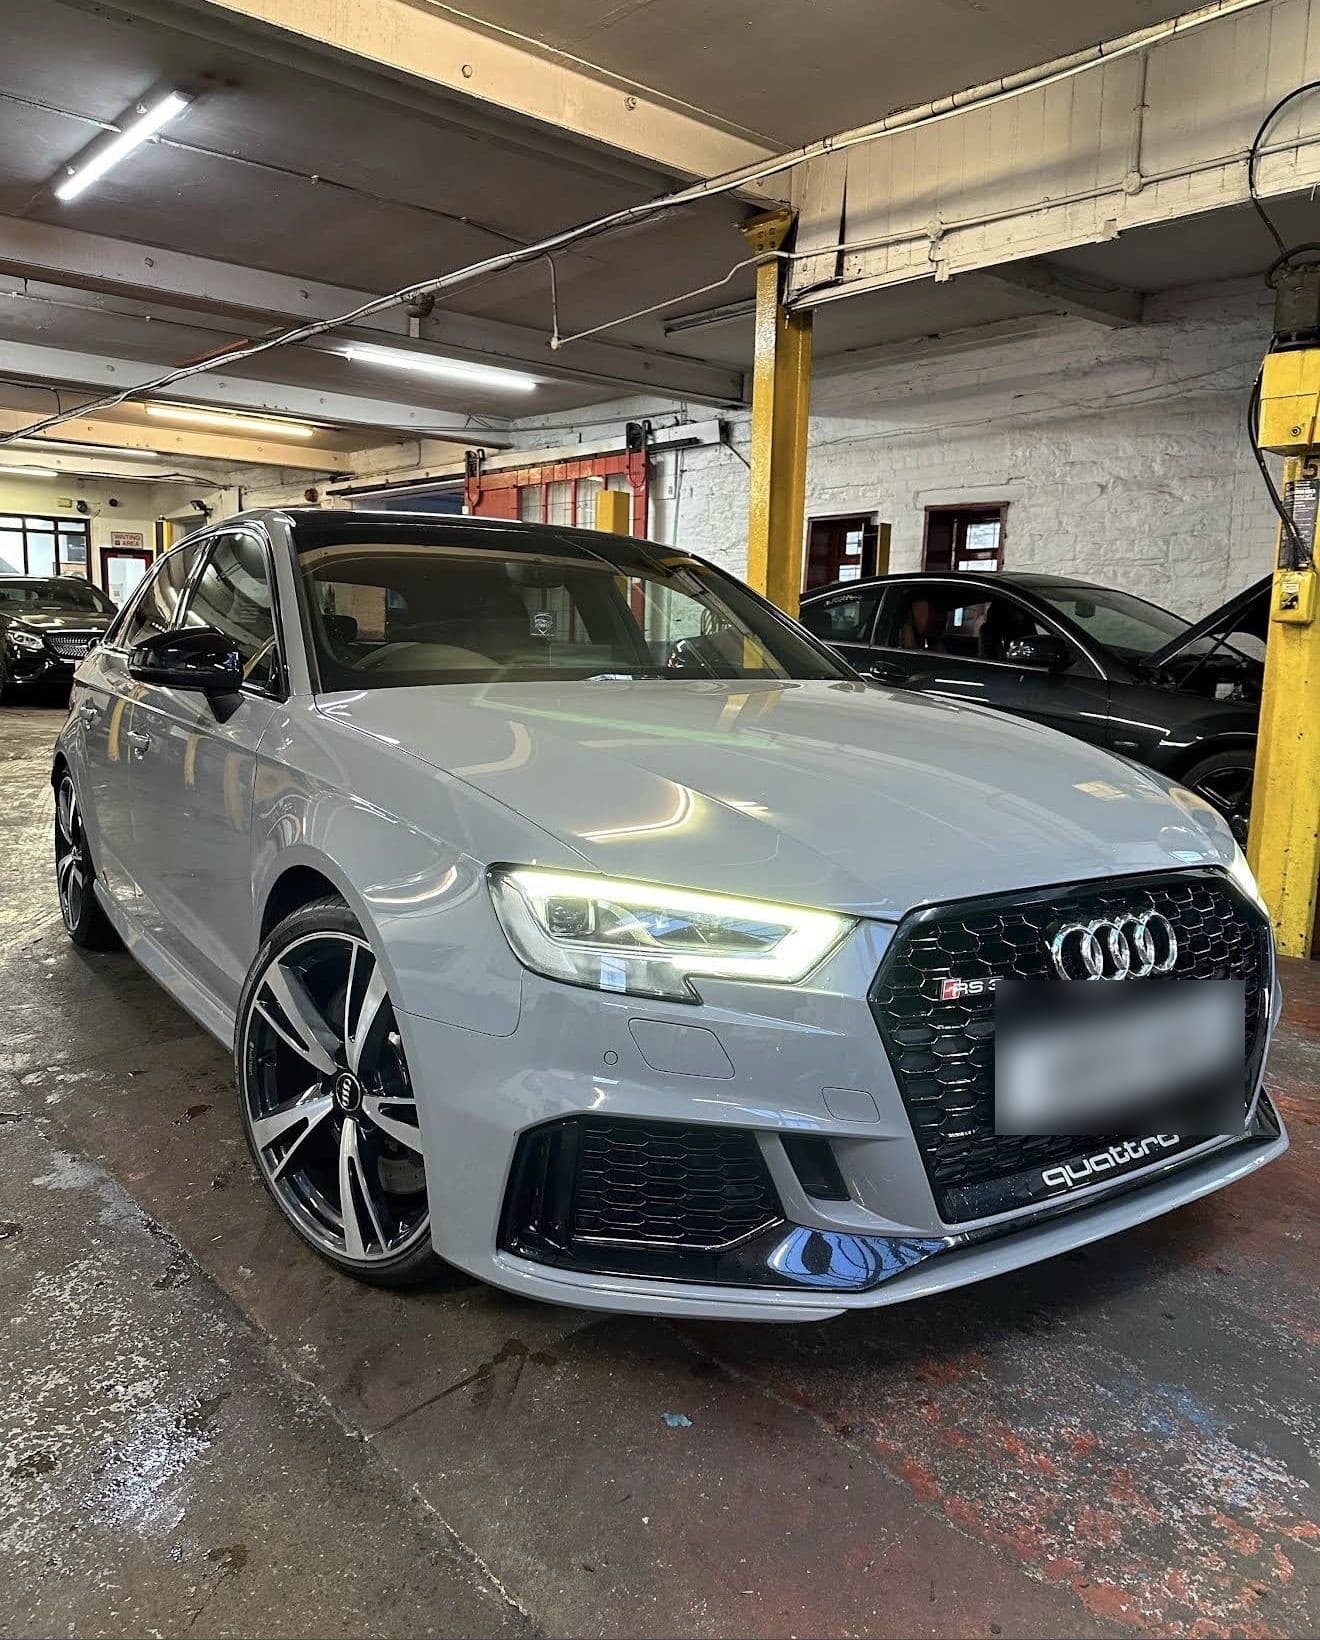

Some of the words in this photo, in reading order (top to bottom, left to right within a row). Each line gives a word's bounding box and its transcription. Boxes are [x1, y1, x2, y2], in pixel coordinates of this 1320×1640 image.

[1303, 454, 1319, 478] 5
[952, 980, 984, 996] RS
[1041, 1134, 1180, 1187] quattro
